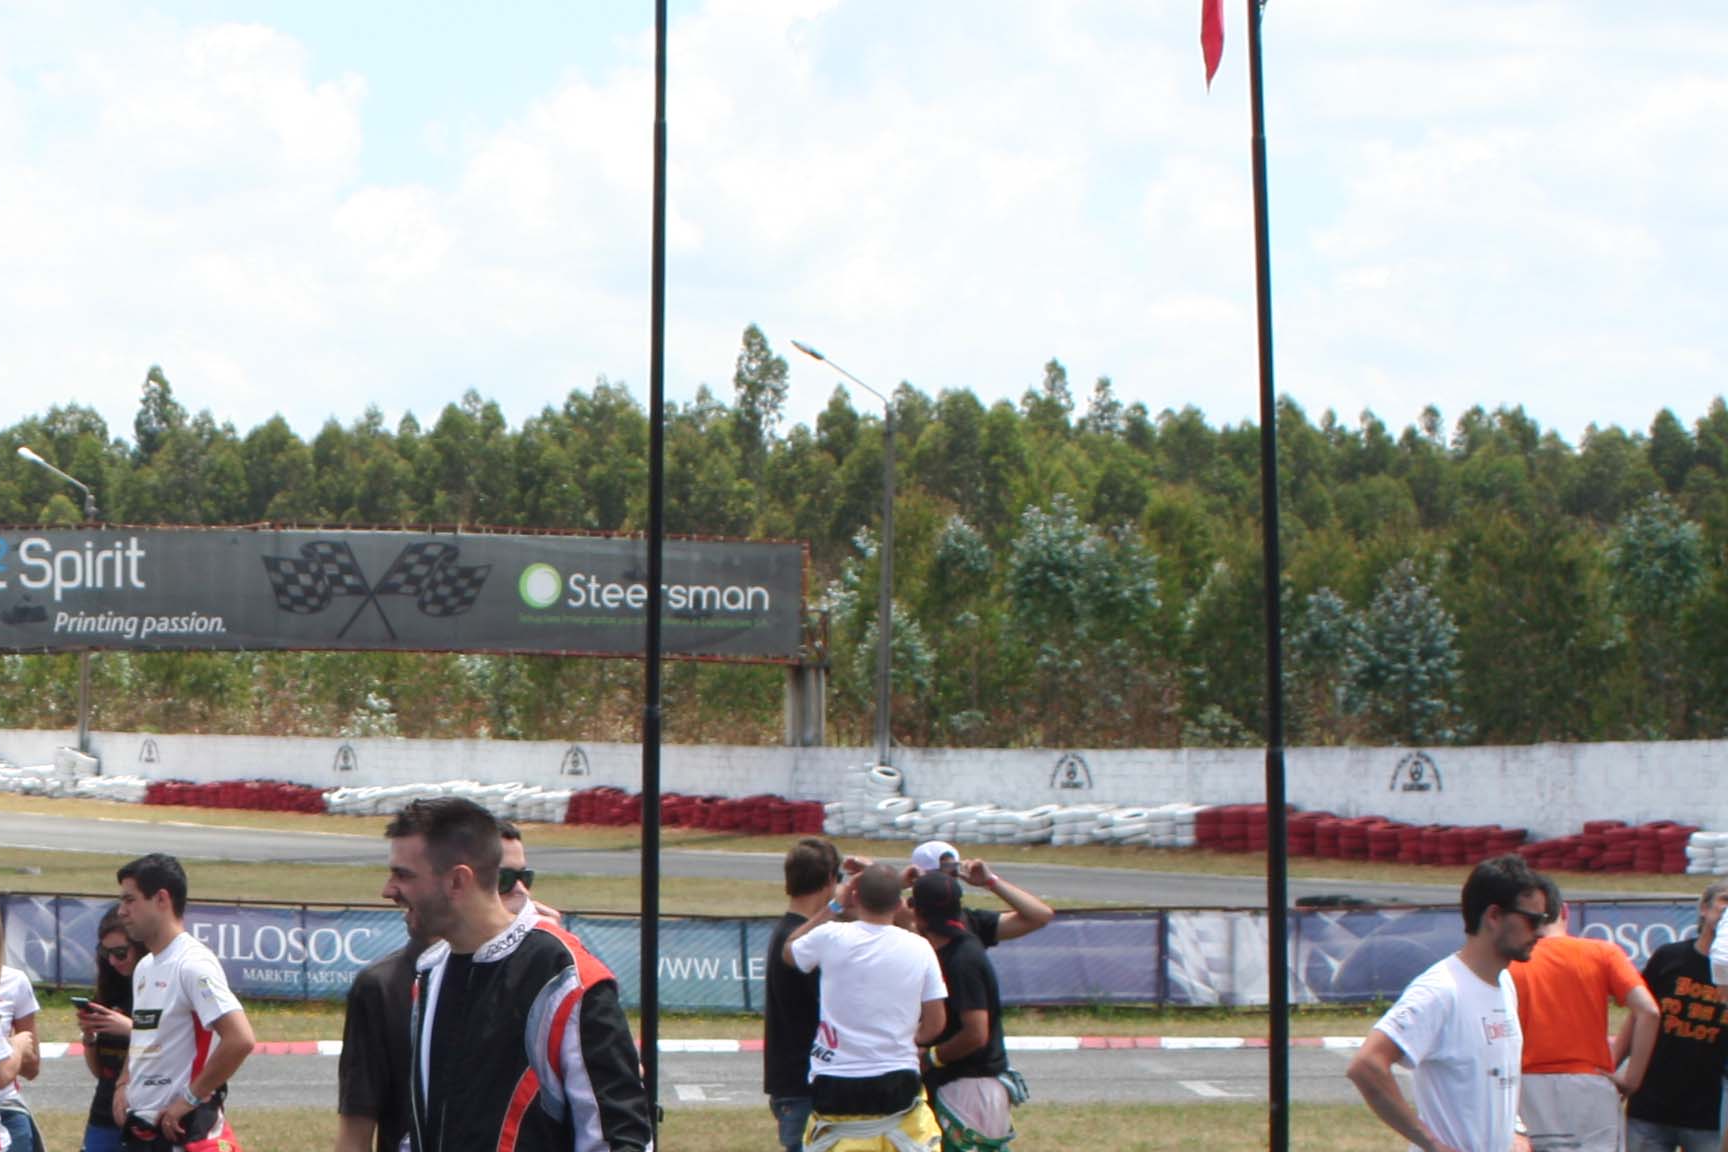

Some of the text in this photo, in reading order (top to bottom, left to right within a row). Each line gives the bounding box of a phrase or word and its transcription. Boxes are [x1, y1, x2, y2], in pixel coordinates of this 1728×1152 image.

[19, 536, 146, 601] Spirit
[53, 611, 228, 638] Printing passion.
[191, 922, 372, 964] EILOSOC
[243, 967, 300, 983] MARKET
